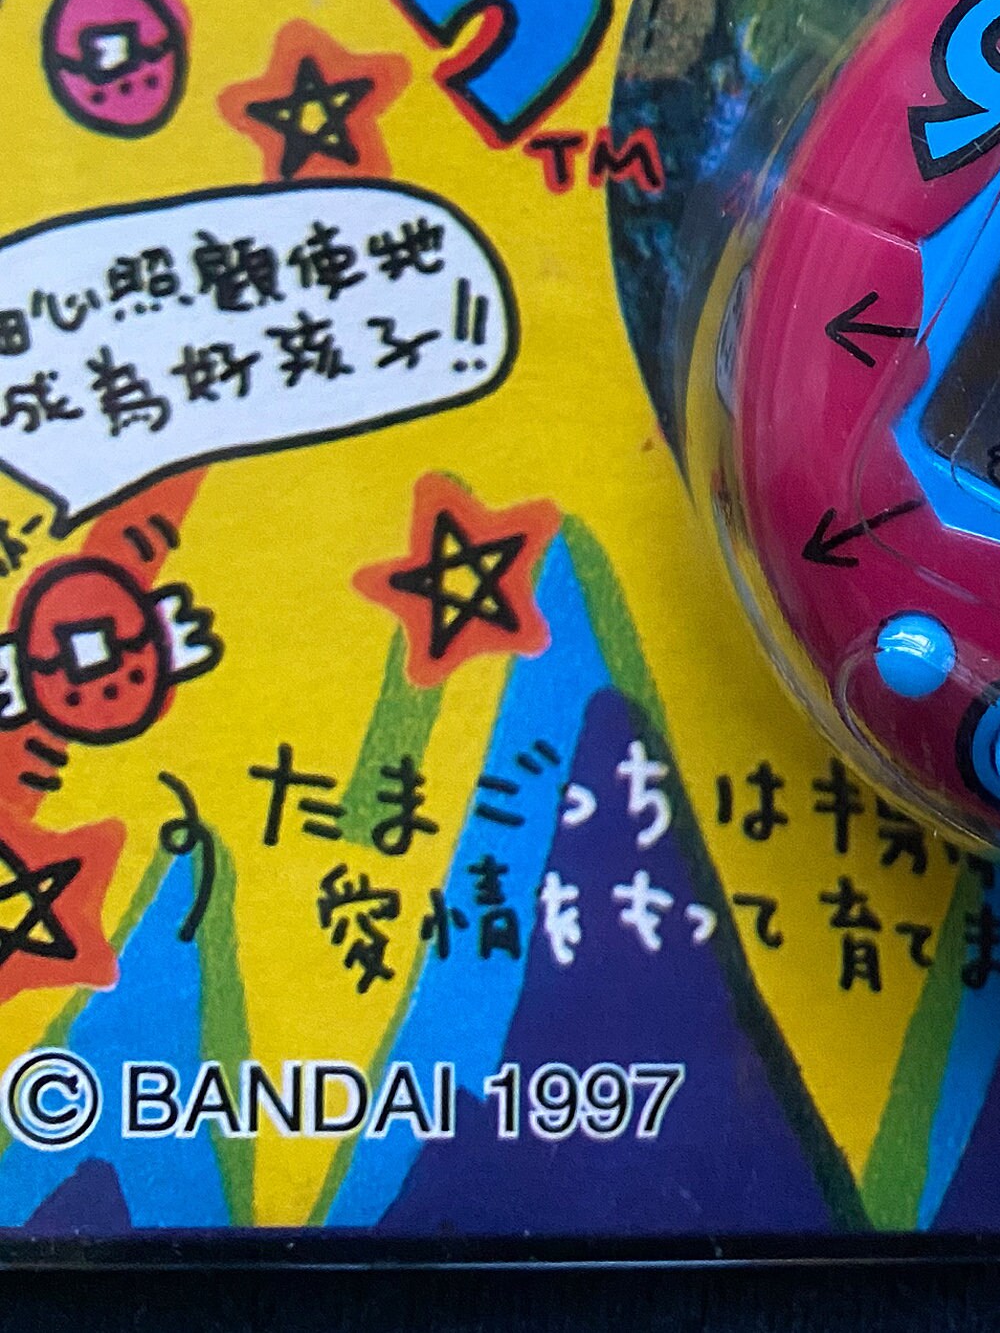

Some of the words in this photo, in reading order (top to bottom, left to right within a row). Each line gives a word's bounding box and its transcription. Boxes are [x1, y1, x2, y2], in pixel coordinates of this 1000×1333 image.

[525, 132, 664, 194] TM
[123, 1062, 455, 1138] BANDAI
[485, 1063, 684, 1138] 1997
